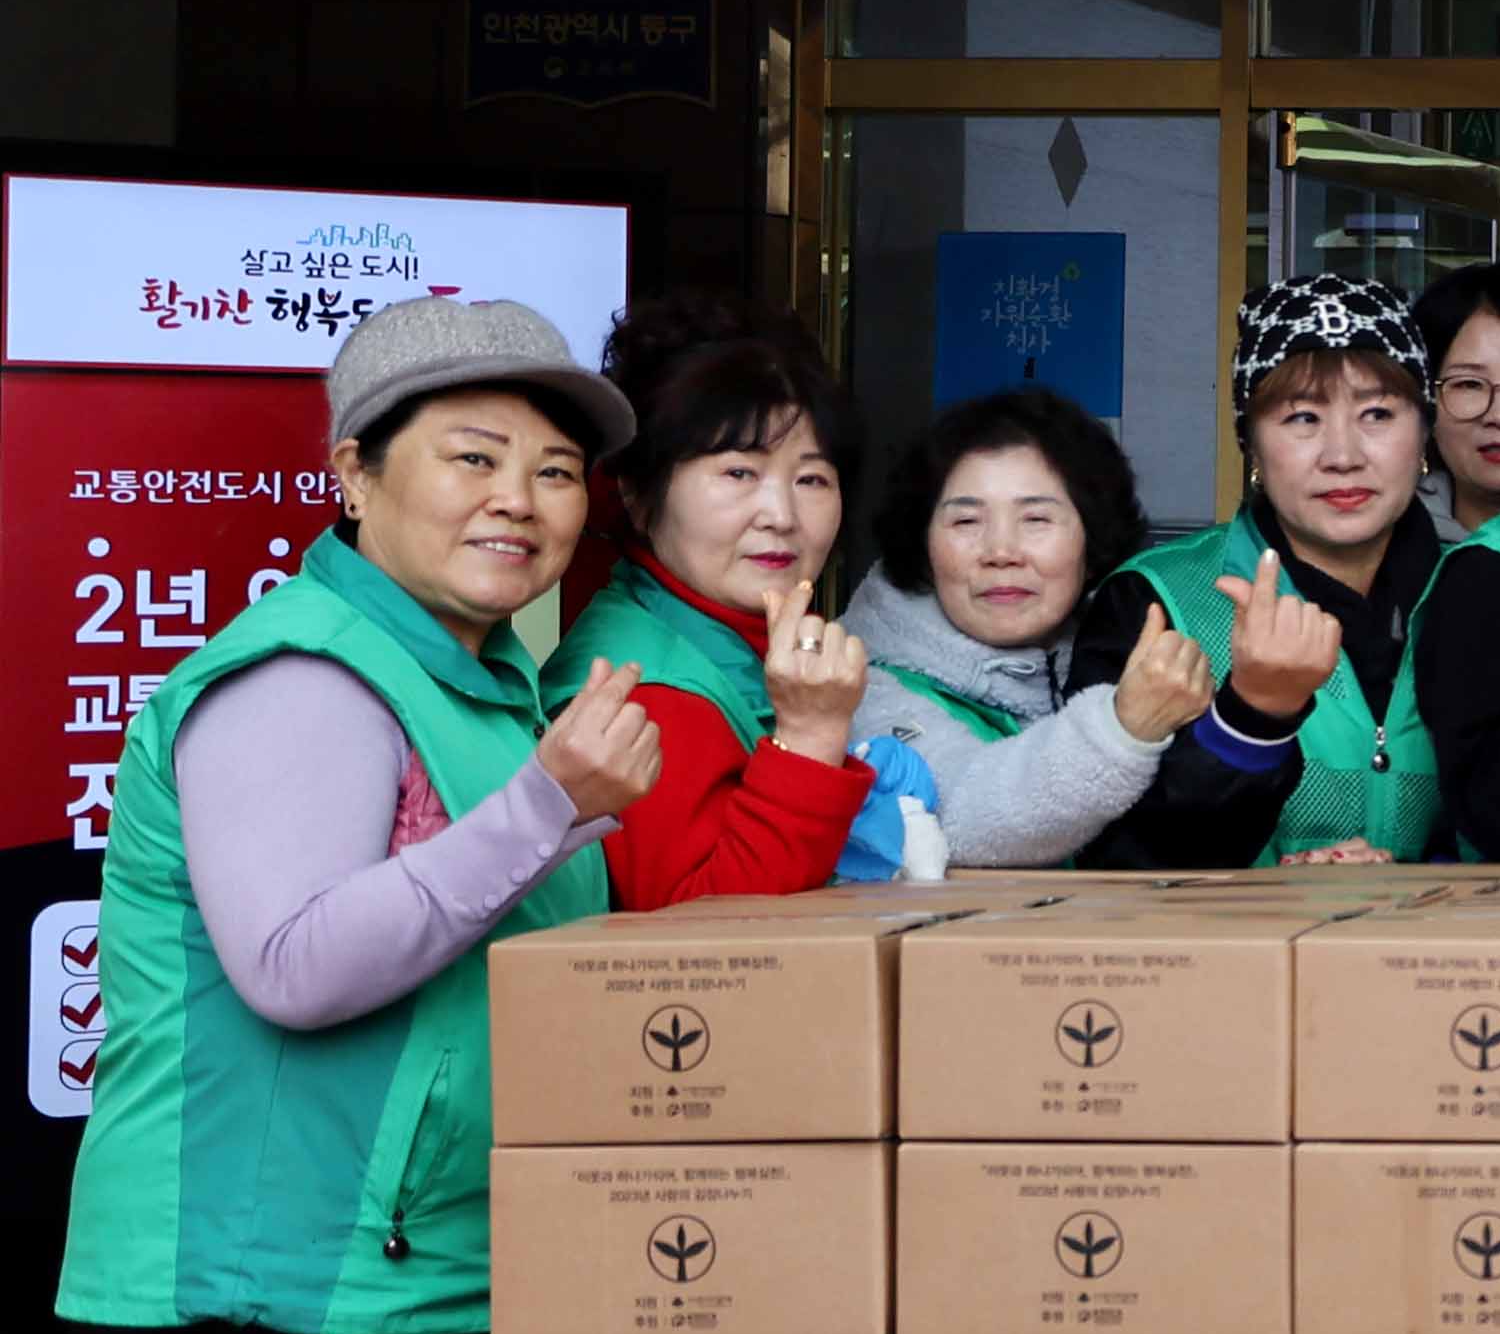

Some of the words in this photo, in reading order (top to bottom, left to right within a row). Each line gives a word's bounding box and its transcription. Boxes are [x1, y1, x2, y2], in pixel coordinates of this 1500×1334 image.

[241, 248, 293, 277] 살고
[301, 251, 353, 279] 싶은
[360, 254, 420, 281] 도시!
[992, 271, 1060, 302] 친환경
[139, 278, 254, 330] 활기찬
[265, 286, 384, 337] 행복도
[979, 298, 1074, 330] 자원순환
[1309, 300, 1349, 336] B
[69, 469, 283, 506] 교통안전도시
[74, 569, 208, 649] 2년
